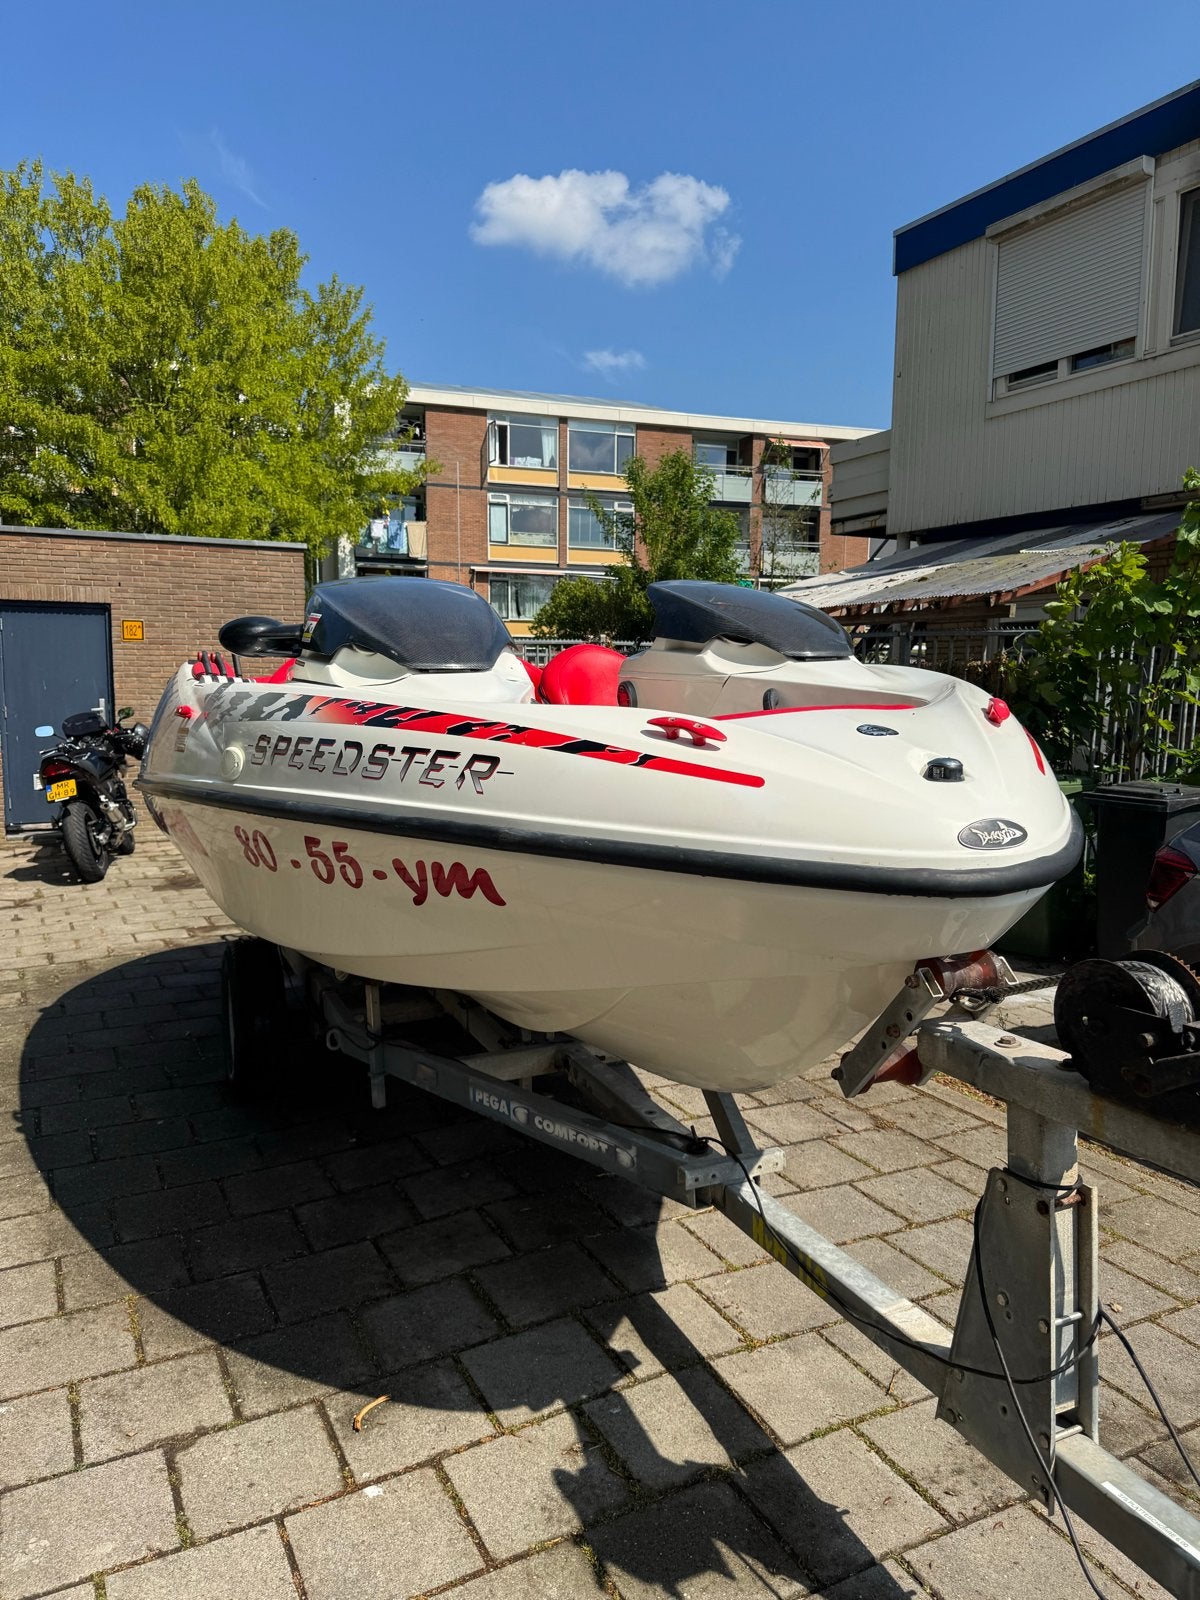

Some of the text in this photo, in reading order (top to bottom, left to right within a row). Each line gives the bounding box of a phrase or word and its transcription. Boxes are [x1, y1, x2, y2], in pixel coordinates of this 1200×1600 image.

[250, 734, 501, 794] SPEEDSTER
[475, 1086, 609, 1153] PEGA COMFORT
